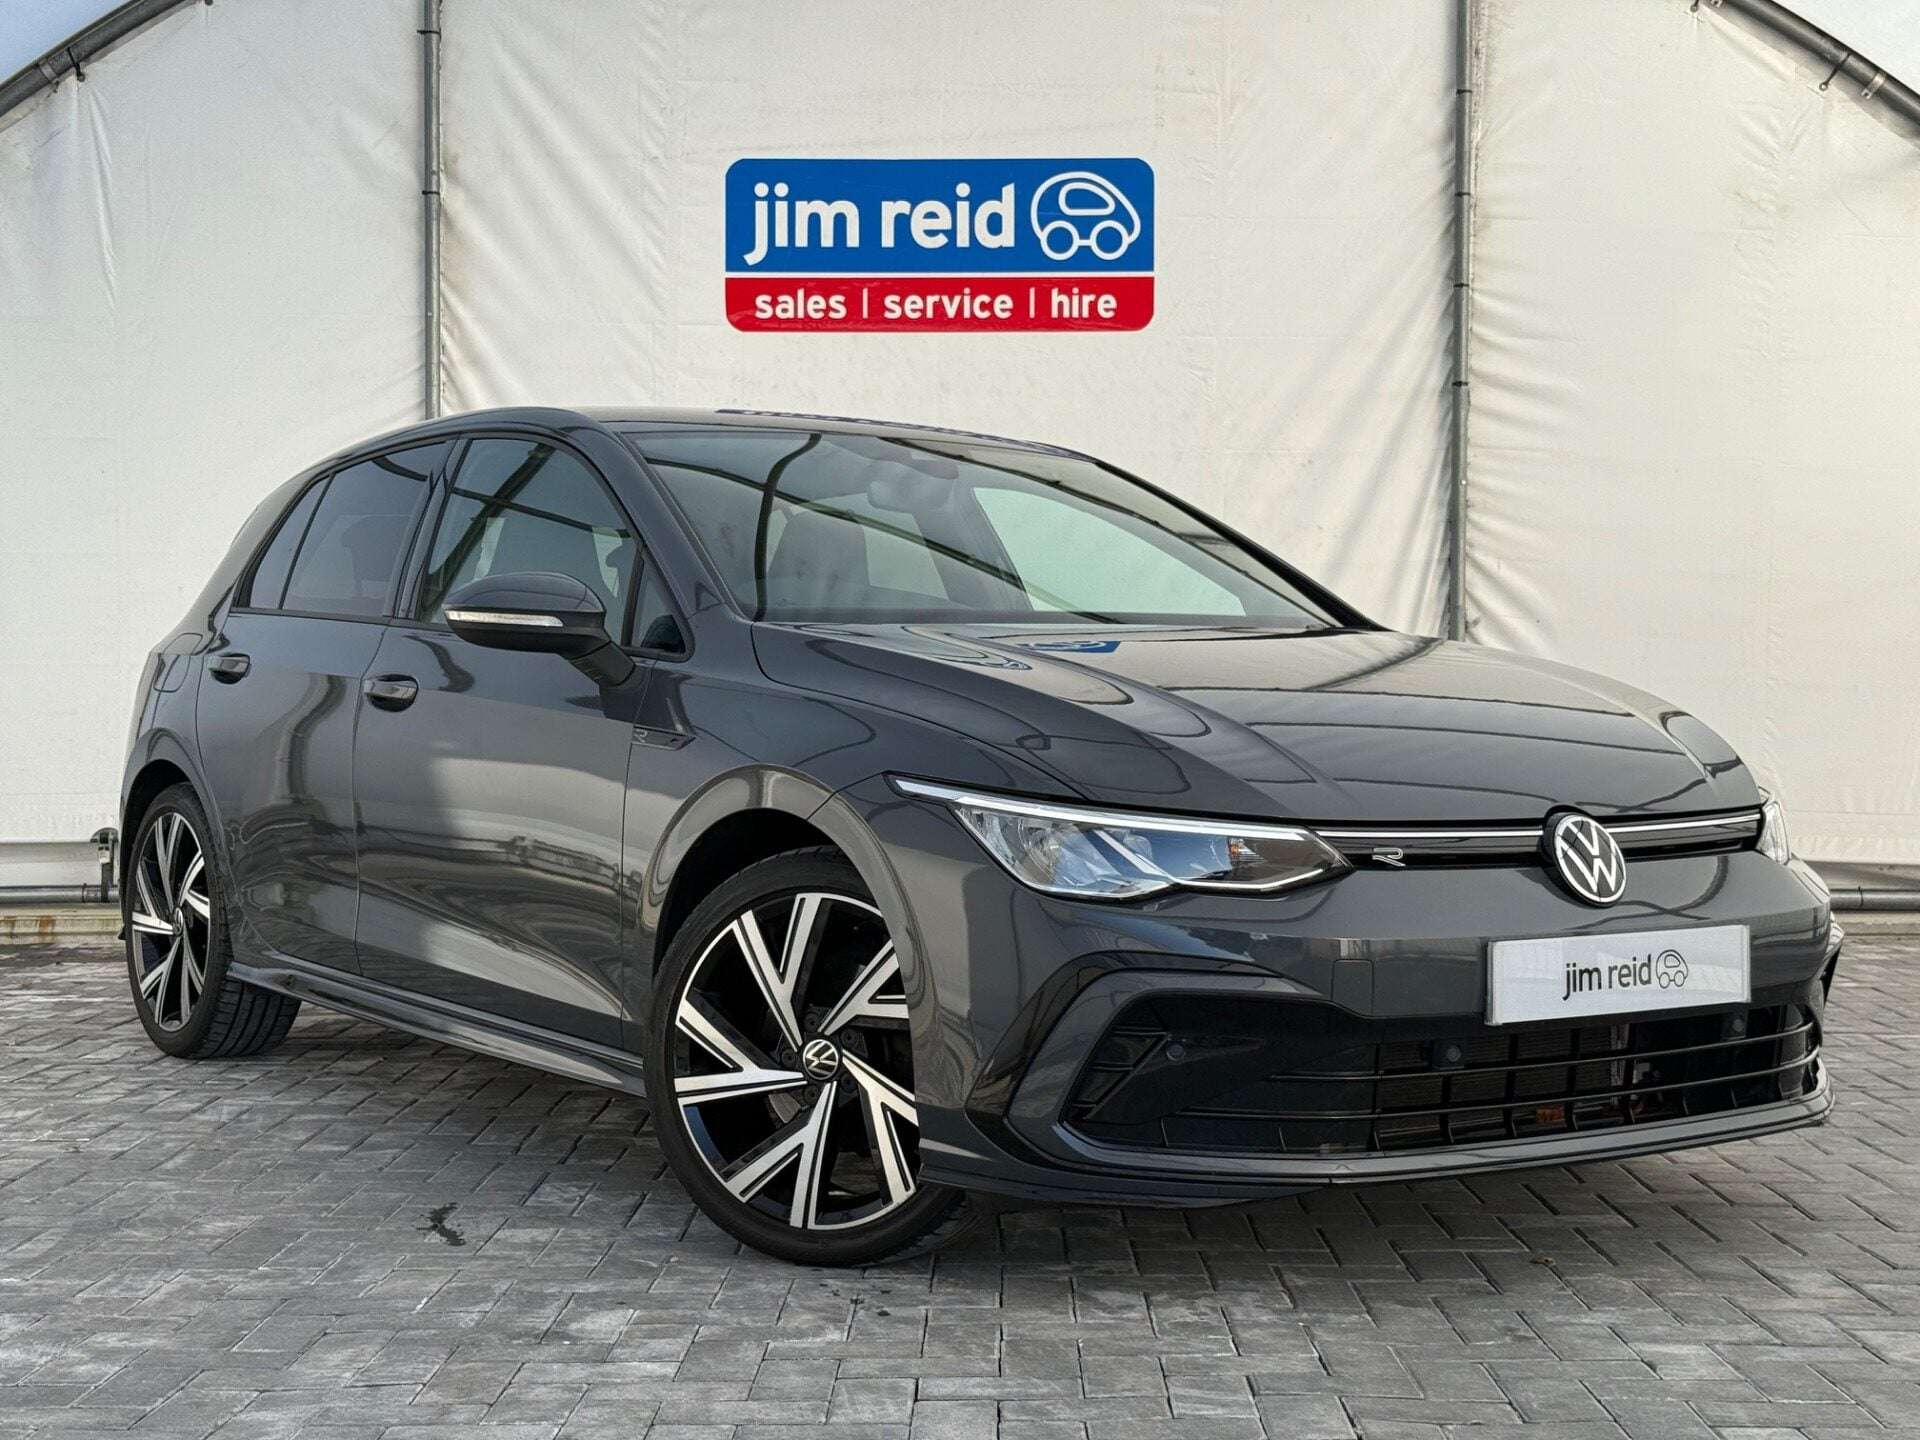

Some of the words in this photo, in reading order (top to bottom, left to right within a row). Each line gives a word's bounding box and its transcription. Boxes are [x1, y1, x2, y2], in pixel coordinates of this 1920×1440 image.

[743, 182, 860, 266] jim
[881, 182, 1015, 249] reid
[755, 288, 847, 319] sales
[884, 287, 1014, 319] service
[1051, 287, 1117, 319] hire
[1372, 847, 1406, 867] R
[1554, 814, 1627, 903] VW
[1562, 962, 1603, 1001] jim
[1608, 953, 1652, 990] reid
